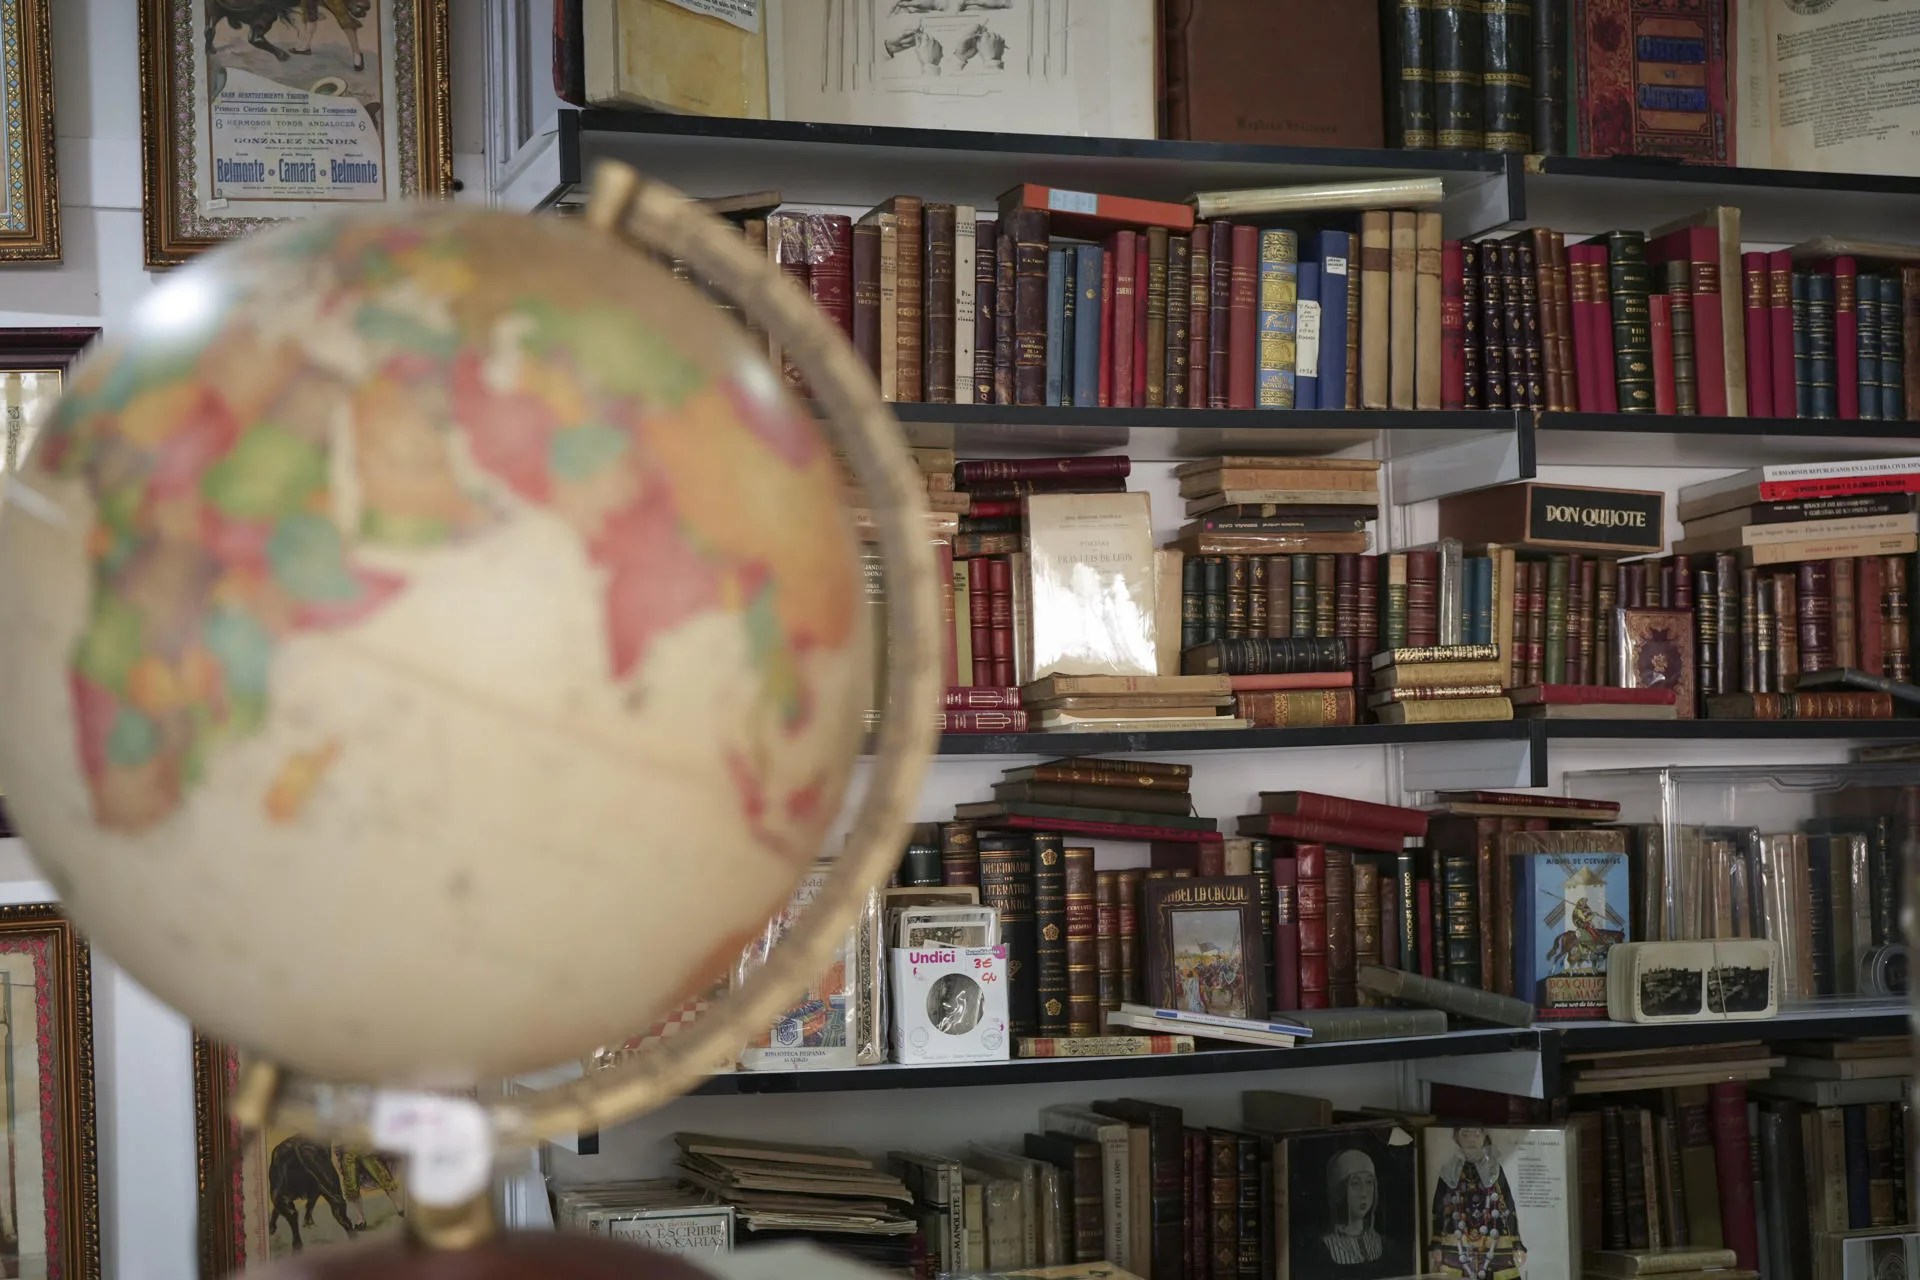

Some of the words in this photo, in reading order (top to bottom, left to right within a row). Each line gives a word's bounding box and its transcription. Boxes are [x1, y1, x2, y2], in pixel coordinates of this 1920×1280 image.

[217, 158, 265, 183] Belmonte
[279, 158, 317, 183] Camará
[330, 158, 378, 184] Belmonte
[1809, 466, 1851, 475] REPUBLICANOS
[1868, 463, 1892, 471] GUERRA
[1545, 504, 1580, 522] DON
[1581, 508, 1646, 527] QUIJOTE
[1404, 871, 1412, 897] TOLEDO
[1194, 886, 1207, 901] LA
[909, 951, 956, 964] Undici
[1575, 978, 1607, 989] QUIJO
[952, 1195, 961, 1249] MANOLETE
[615, 1229, 652, 1241] PARA
